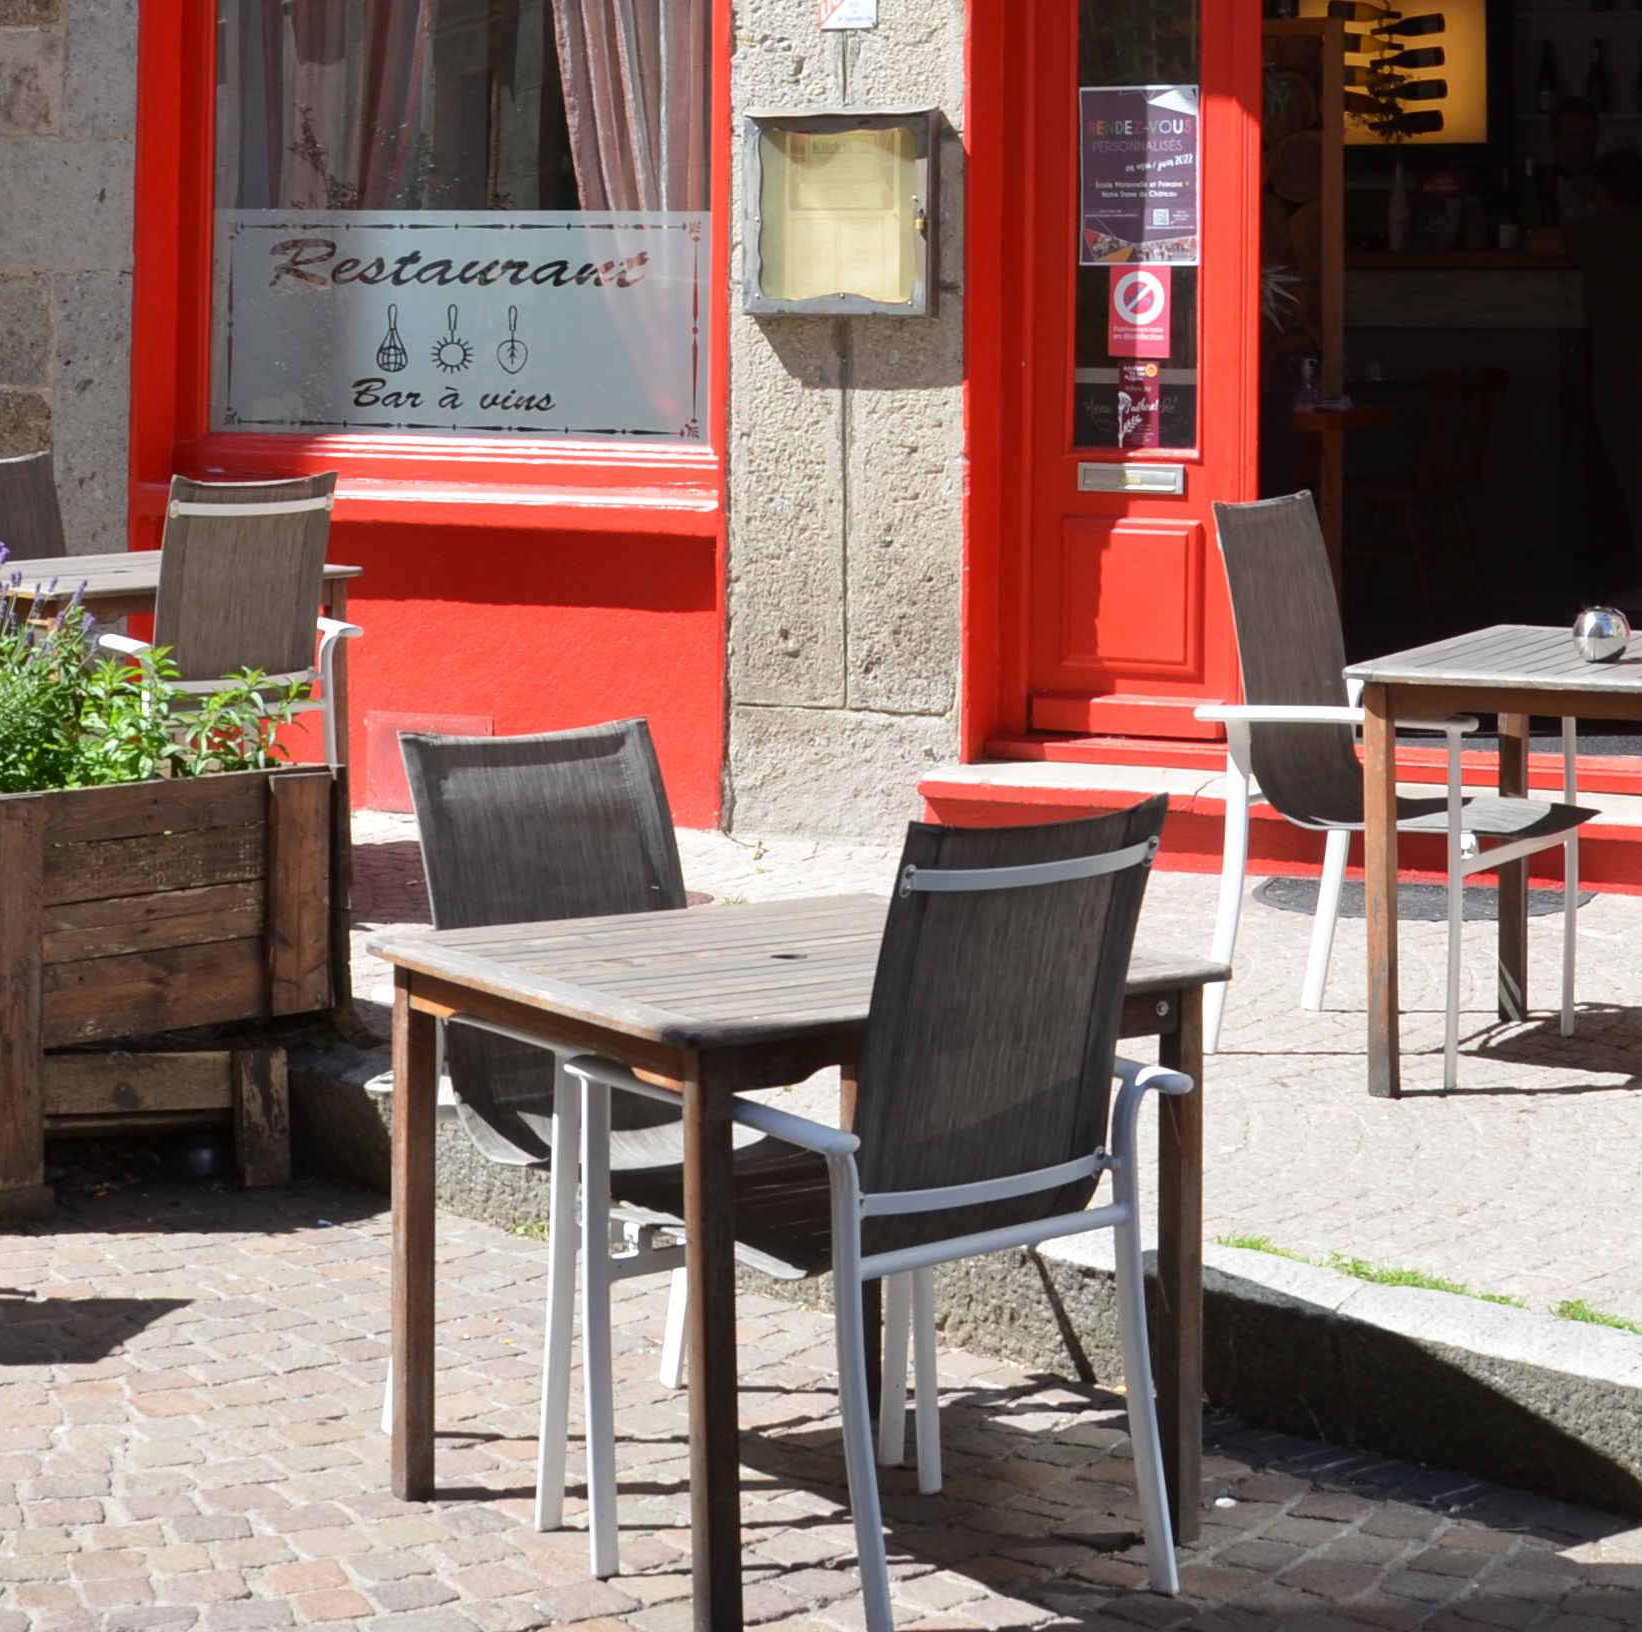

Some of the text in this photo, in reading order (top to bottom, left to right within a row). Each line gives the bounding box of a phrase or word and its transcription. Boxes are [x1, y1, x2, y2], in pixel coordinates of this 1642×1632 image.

[1088, 119, 1194, 135] RENDEZ-VOUS
[1092, 138, 1183, 153] PERSONNALISÉS
[1174, 153, 1193, 166] 2022
[269, 237, 649, 290] Restaurant
[351, 377, 556, 412] Bar à vins
